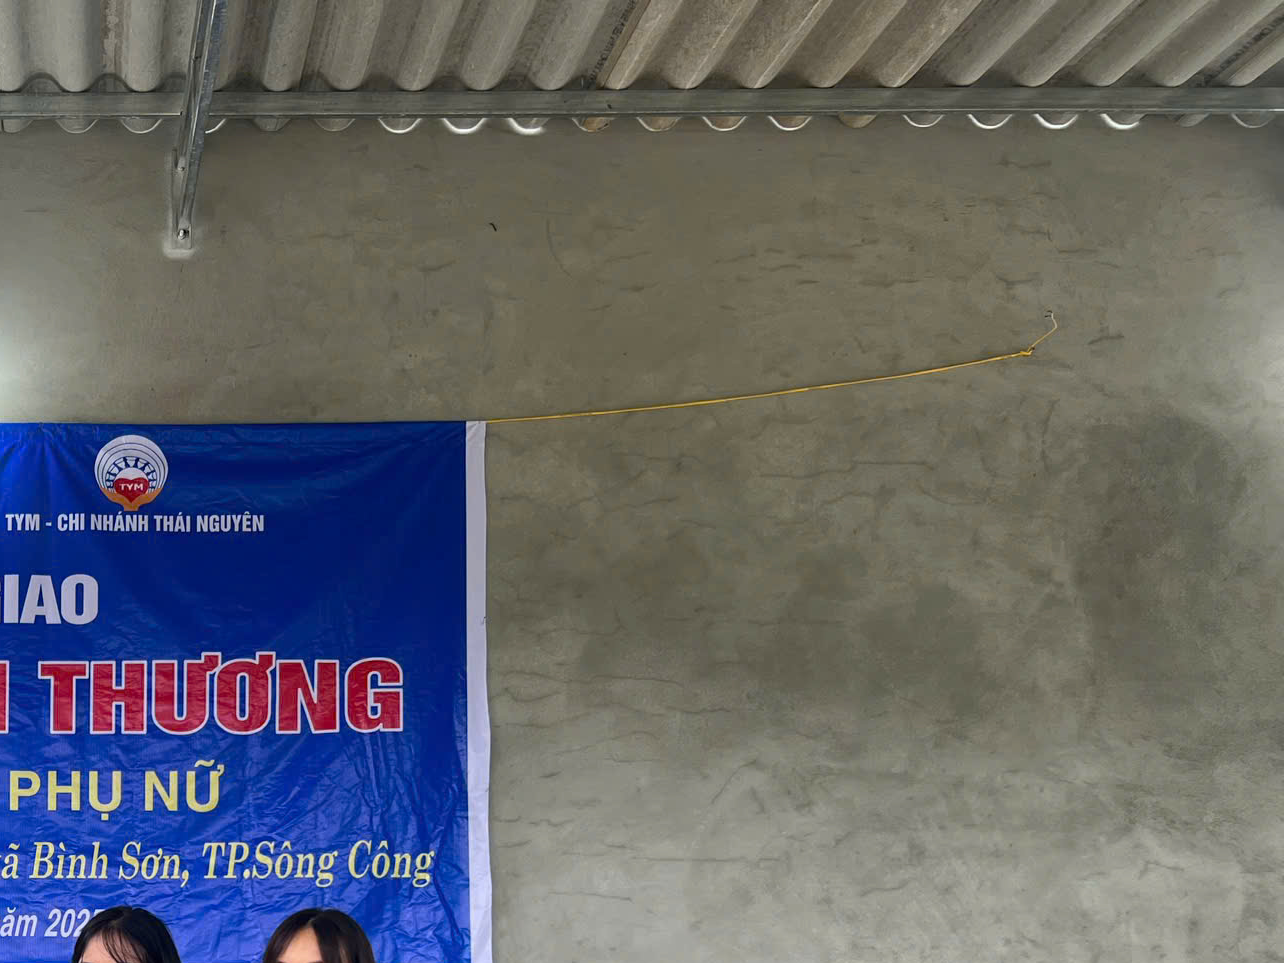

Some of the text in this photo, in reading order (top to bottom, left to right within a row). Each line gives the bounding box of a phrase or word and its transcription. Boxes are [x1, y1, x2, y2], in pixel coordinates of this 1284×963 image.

[119, 483, 144, 491] TYM
[5, 513, 41, 531] TYM
[57, 513, 85, 532] CHI
[90, 509, 149, 532] NHÁNH
[153, 511, 191, 532] THÁI
[196, 511, 265, 532] NGUYÊN
[38, 651, 404, 735] THƯƠNG
[9, 769, 122, 821] PHỤ
[144, 760, 225, 813] NỮ
[29, 840, 108, 880] Bình
[119, 841, 191, 887] Sơn,
[202, 840, 337, 887] TP.Sông
[348, 839, 436, 887] Công
[44, 908, 106, 938] 202
